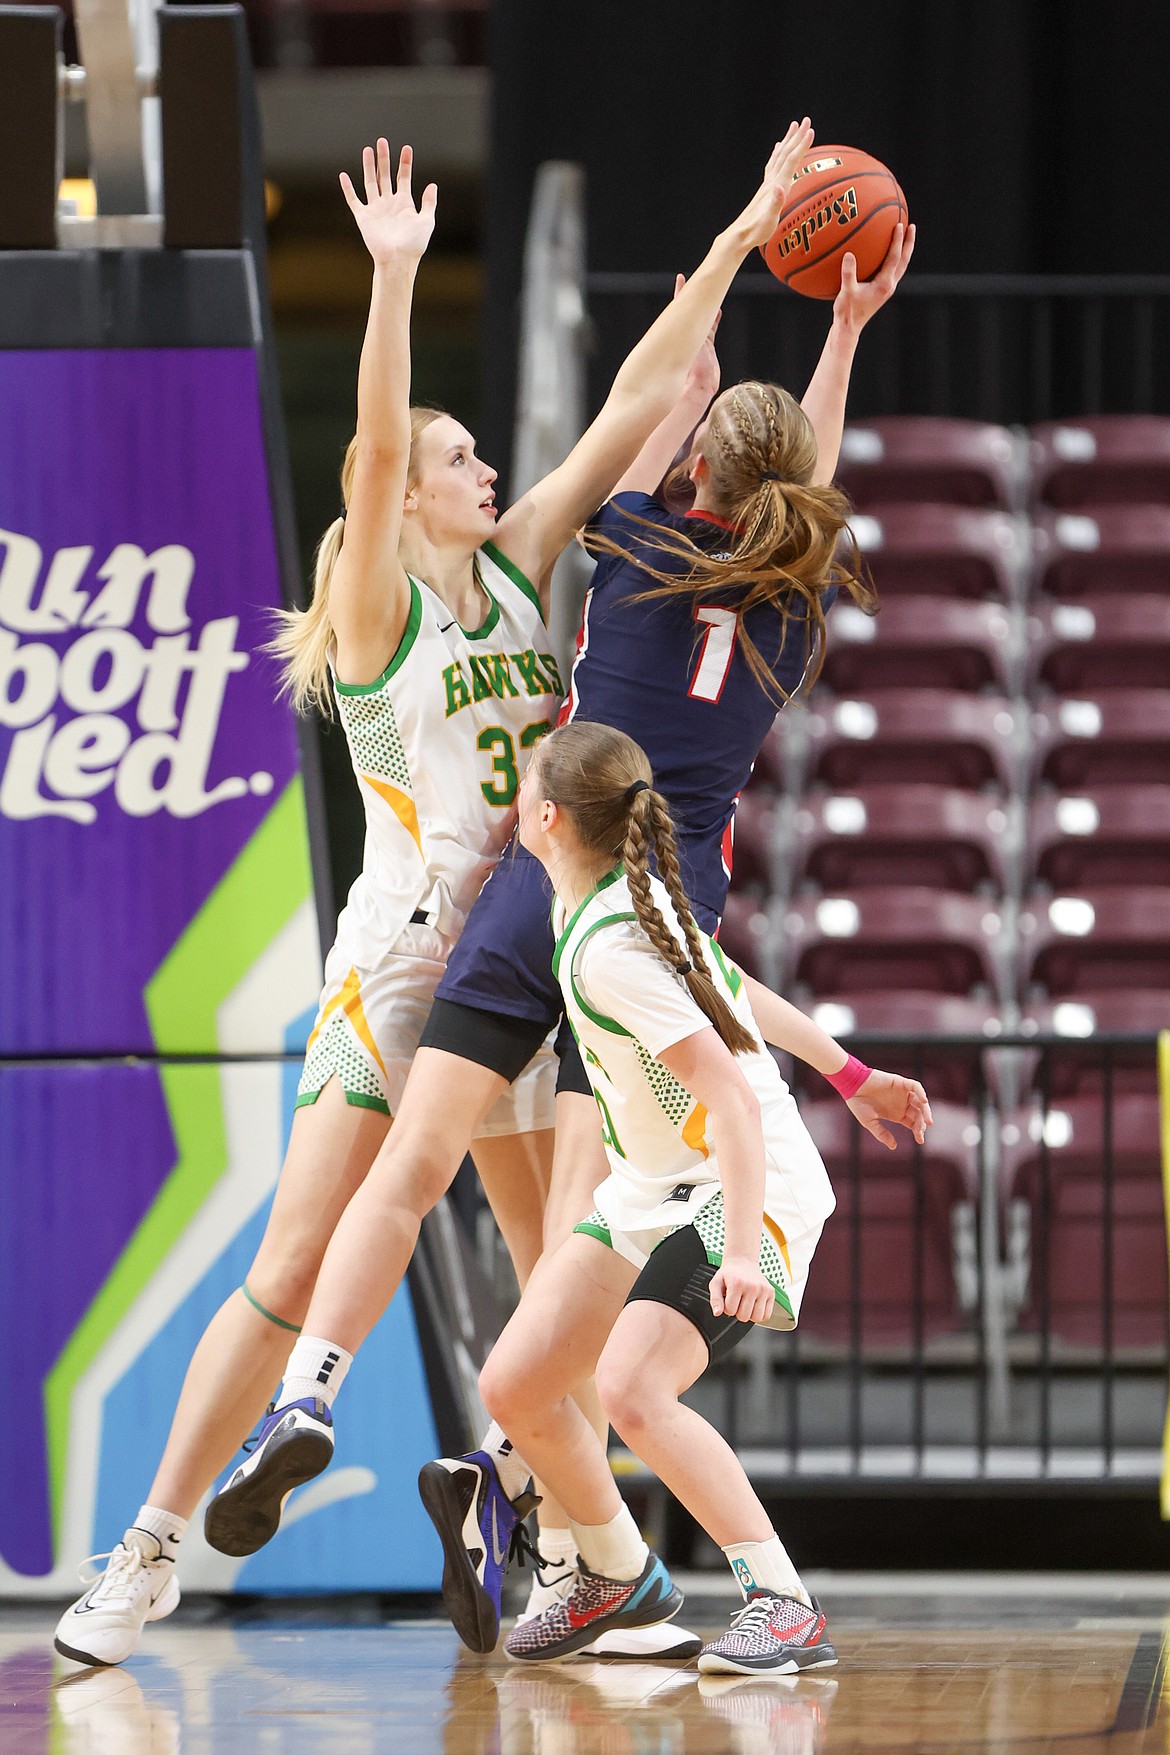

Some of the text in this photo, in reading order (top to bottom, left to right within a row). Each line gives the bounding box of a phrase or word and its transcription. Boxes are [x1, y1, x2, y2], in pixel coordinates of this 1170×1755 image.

[778, 187, 858, 259] Baden
[441, 648, 567, 719] HAWKS
[687, 605, 739, 704] 1
